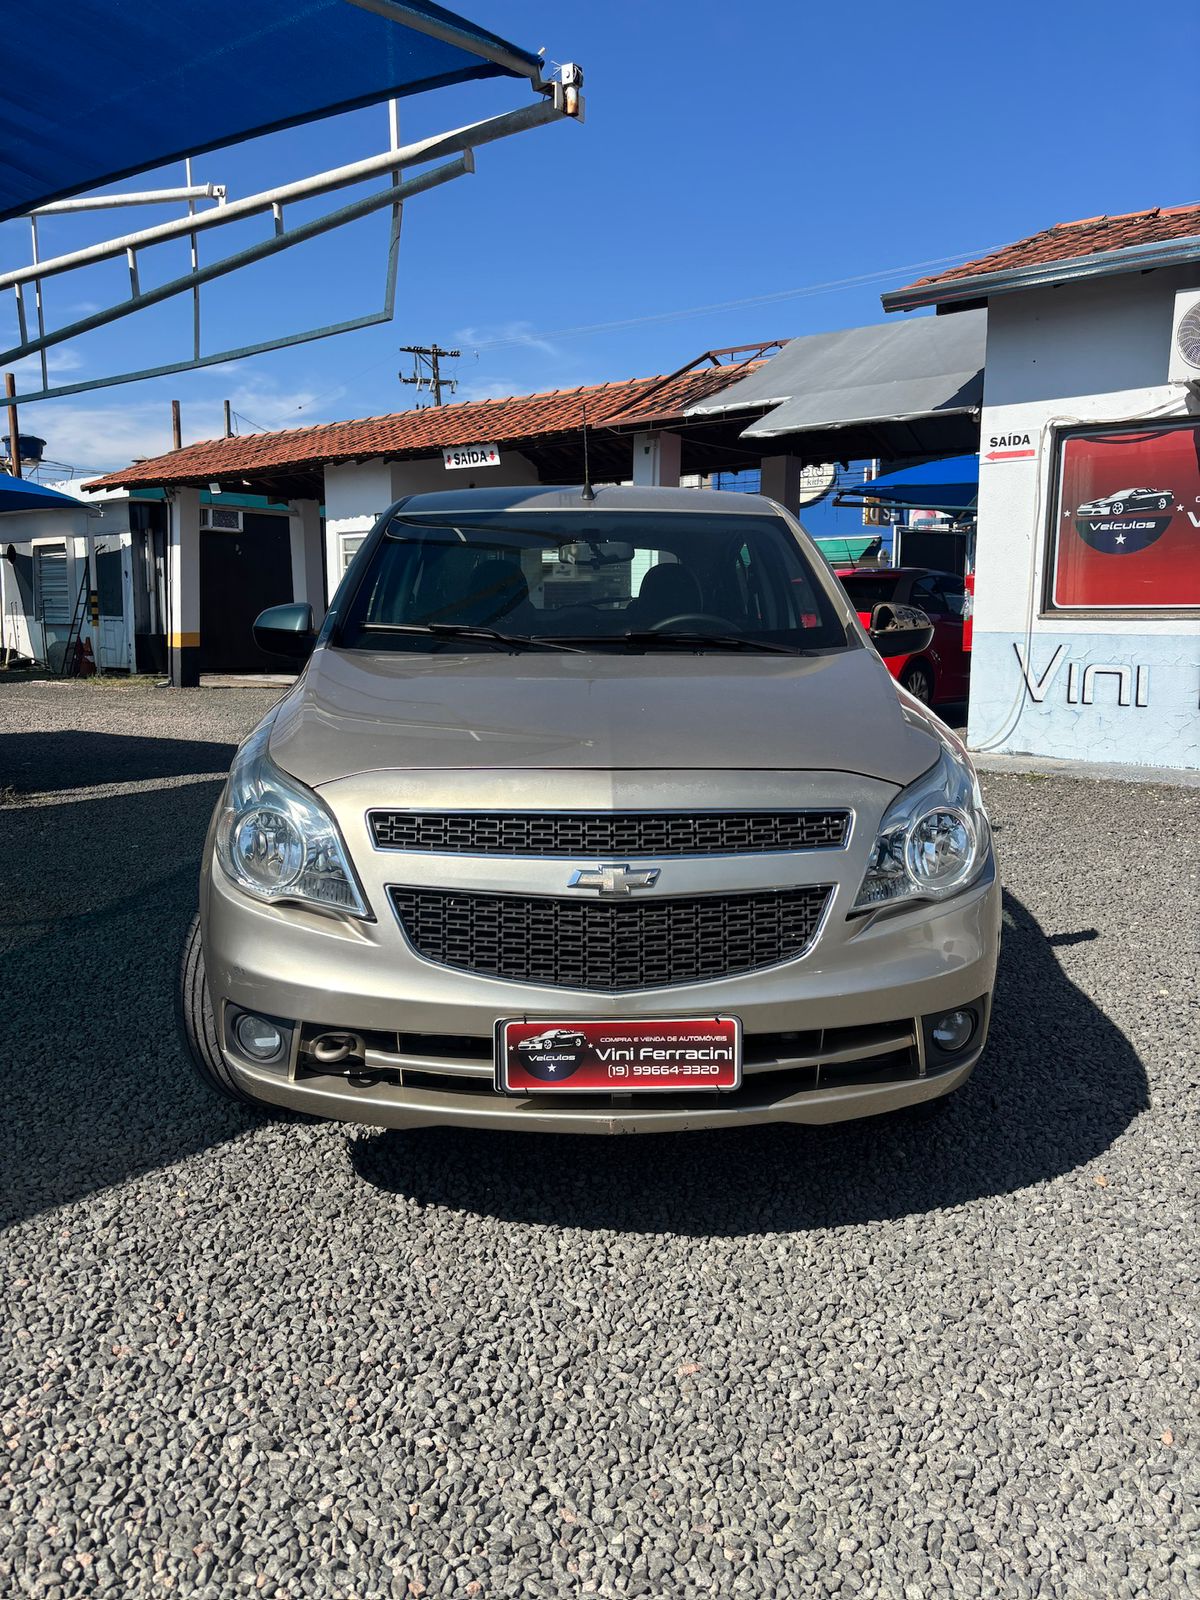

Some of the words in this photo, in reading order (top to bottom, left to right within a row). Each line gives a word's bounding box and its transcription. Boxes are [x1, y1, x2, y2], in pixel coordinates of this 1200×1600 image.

[990, 432, 1031, 448] SAÍDA
[453, 448, 488, 466] SAÍDA
[1089, 520, 1157, 531] Veículos
[679, 1034, 728, 1042] AUTOMÓVEIS
[528, 1054, 576, 1062] Veículos
[594, 1047, 634, 1061] Vini
[639, 1046, 733, 1060] Ferracini
[608, 1064, 629, 1078] (19)
[633, 1064, 720, 1076] 99664-3320
